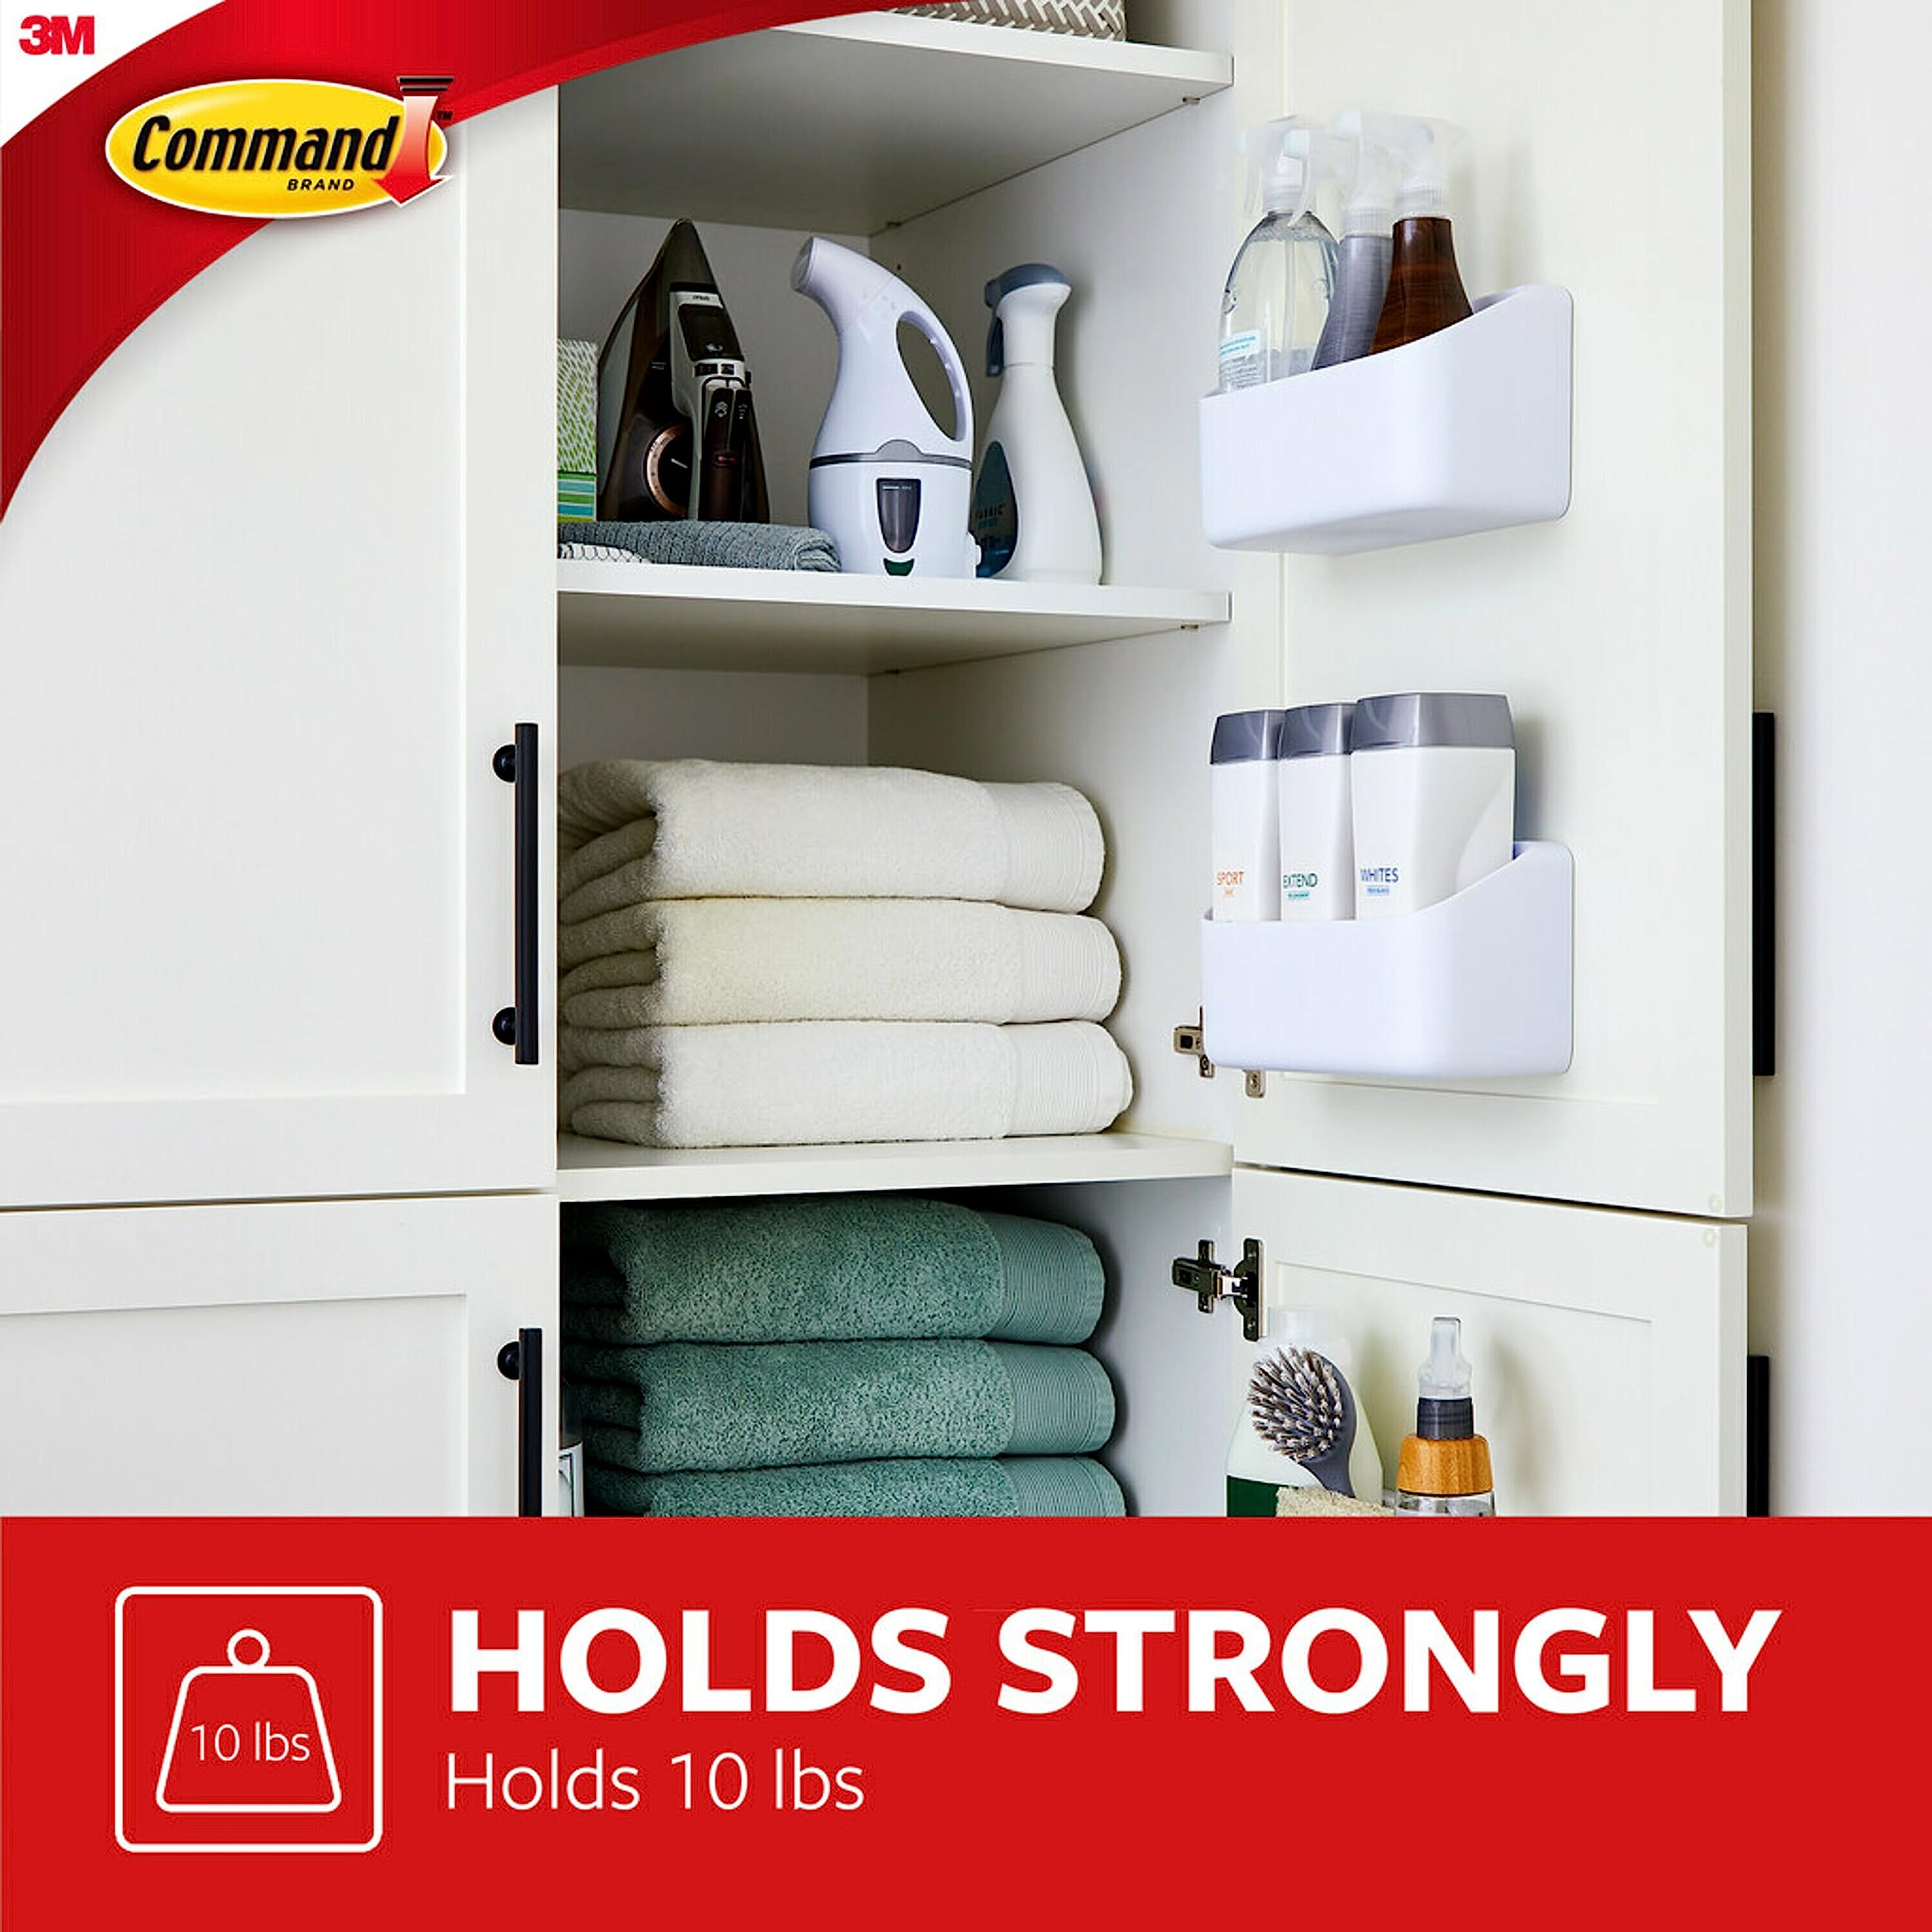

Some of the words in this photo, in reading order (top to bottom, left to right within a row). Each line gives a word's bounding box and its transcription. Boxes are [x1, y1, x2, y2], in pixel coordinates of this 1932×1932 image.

[1217, 871, 1244, 886] SPORT
[1283, 872, 1318, 888] EXTEND
[1360, 868, 1398, 883] WHITES
